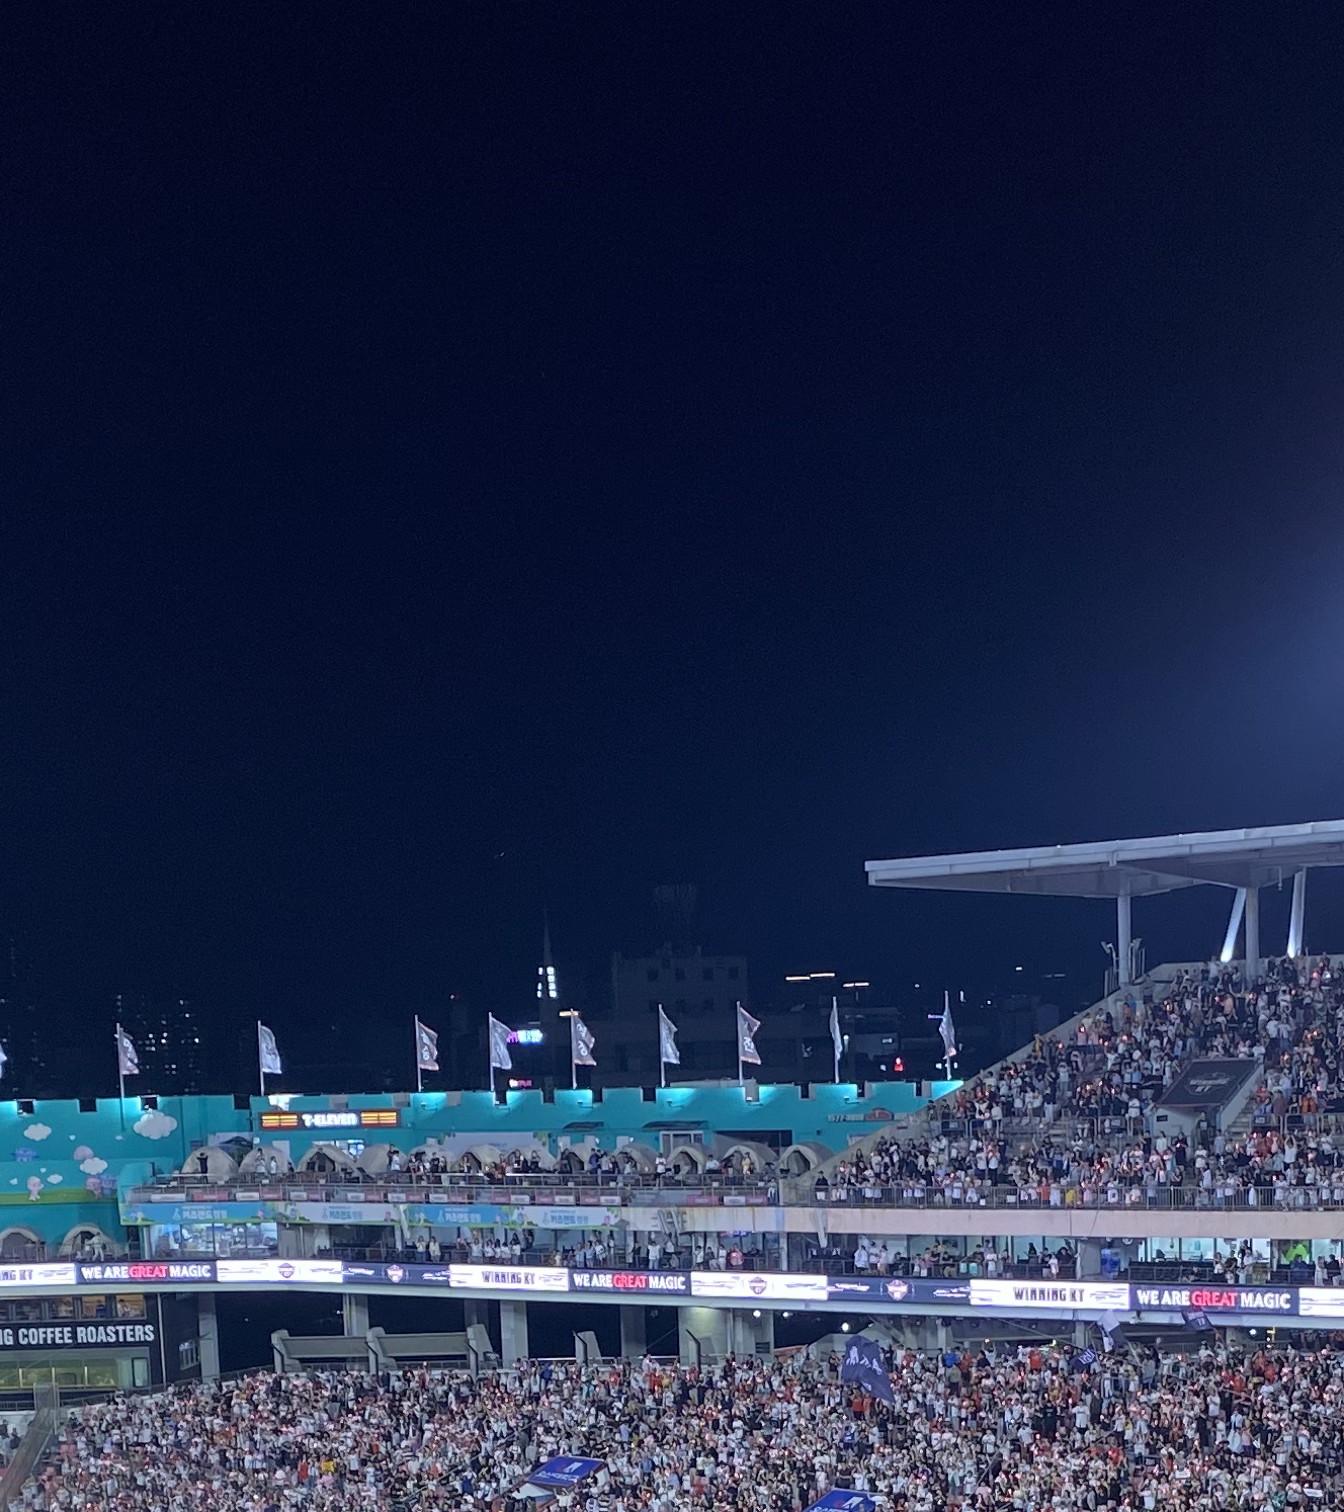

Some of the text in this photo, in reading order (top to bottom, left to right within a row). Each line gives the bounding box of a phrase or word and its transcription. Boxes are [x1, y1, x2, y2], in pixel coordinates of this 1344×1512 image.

[81, 1264, 211, 1279] WE ARE GREAT MAGIC
[573, 1273, 686, 1290] WE ARE GREAT MAGIC
[1014, 1285, 1085, 1303] WINNING KT
[1137, 1288, 1291, 1309] WE ARE GREAT MAGIC
[18, 1327, 72, 1346] COFFEE
[77, 1324, 155, 1344] ROASTERS
